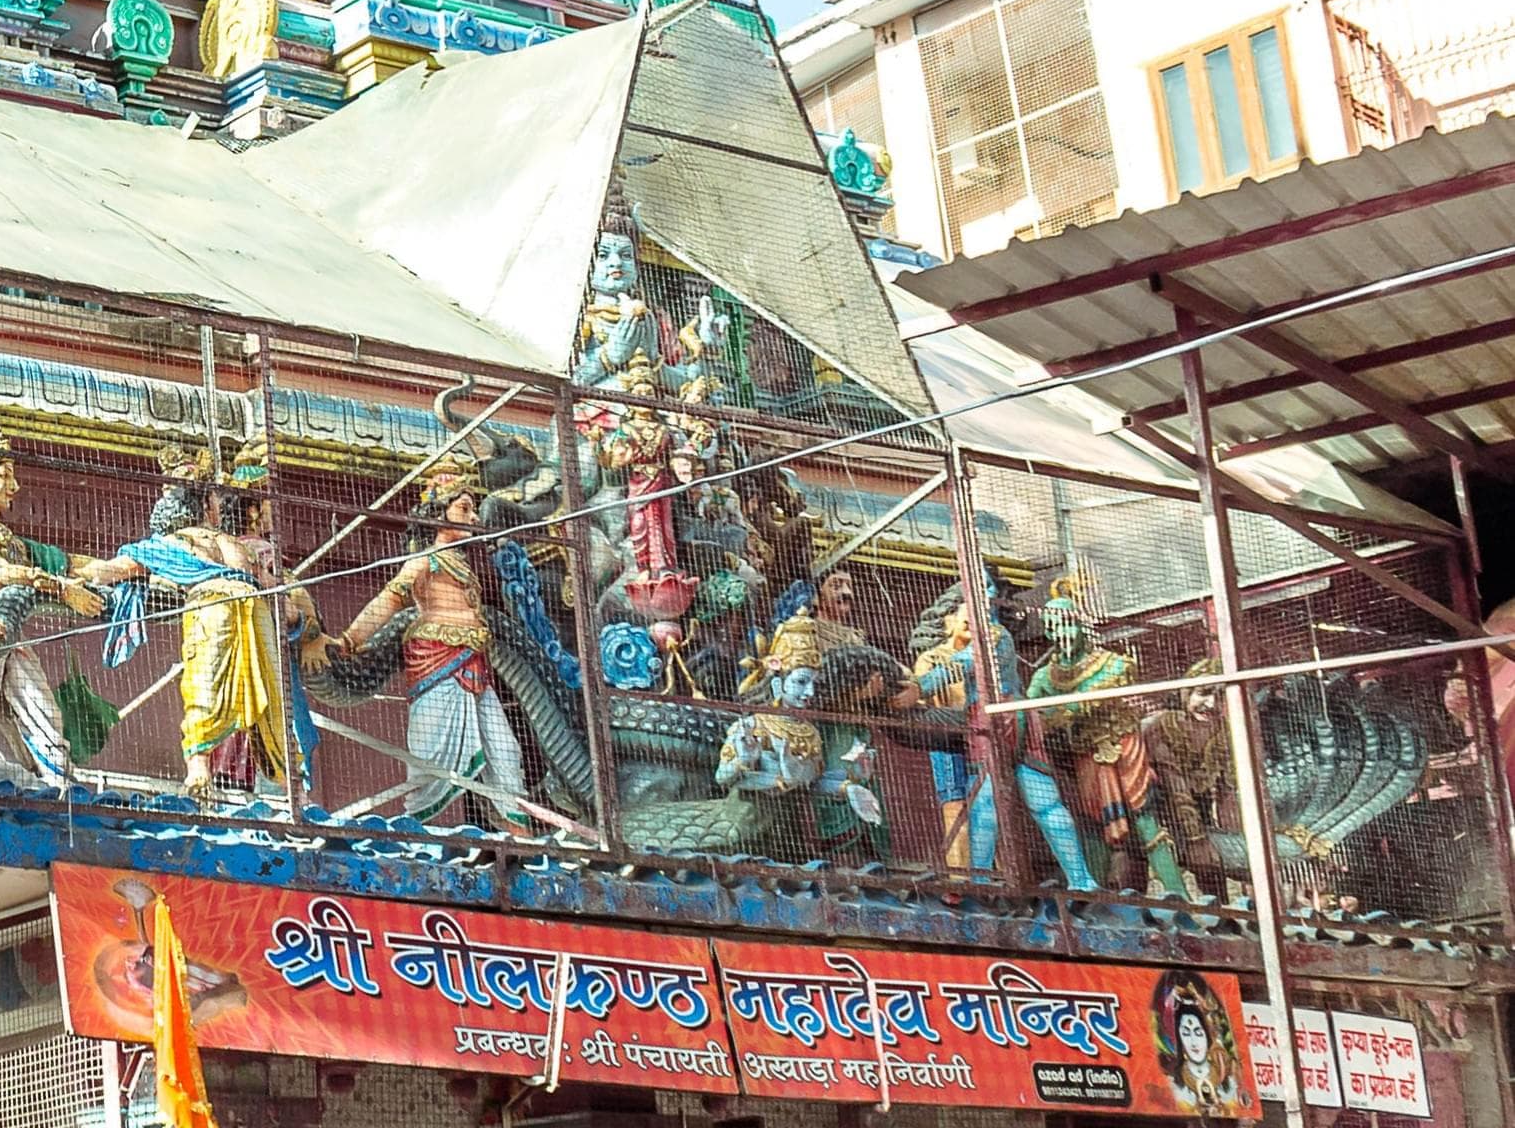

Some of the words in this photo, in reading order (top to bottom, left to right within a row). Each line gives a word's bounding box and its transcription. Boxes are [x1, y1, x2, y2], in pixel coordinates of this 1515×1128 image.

[264, 897, 381, 996] श्री
[384, 910, 710, 1029] नीलकण्ठ
[722, 952, 941, 1047] महादेव
[938, 962, 1132, 1056] मन्दिर
[581, 1029, 622, 1067] श्री
[624, 1034, 732, 1078] पंचायती
[839, 1052, 977, 1089] महनिर्वाणी
